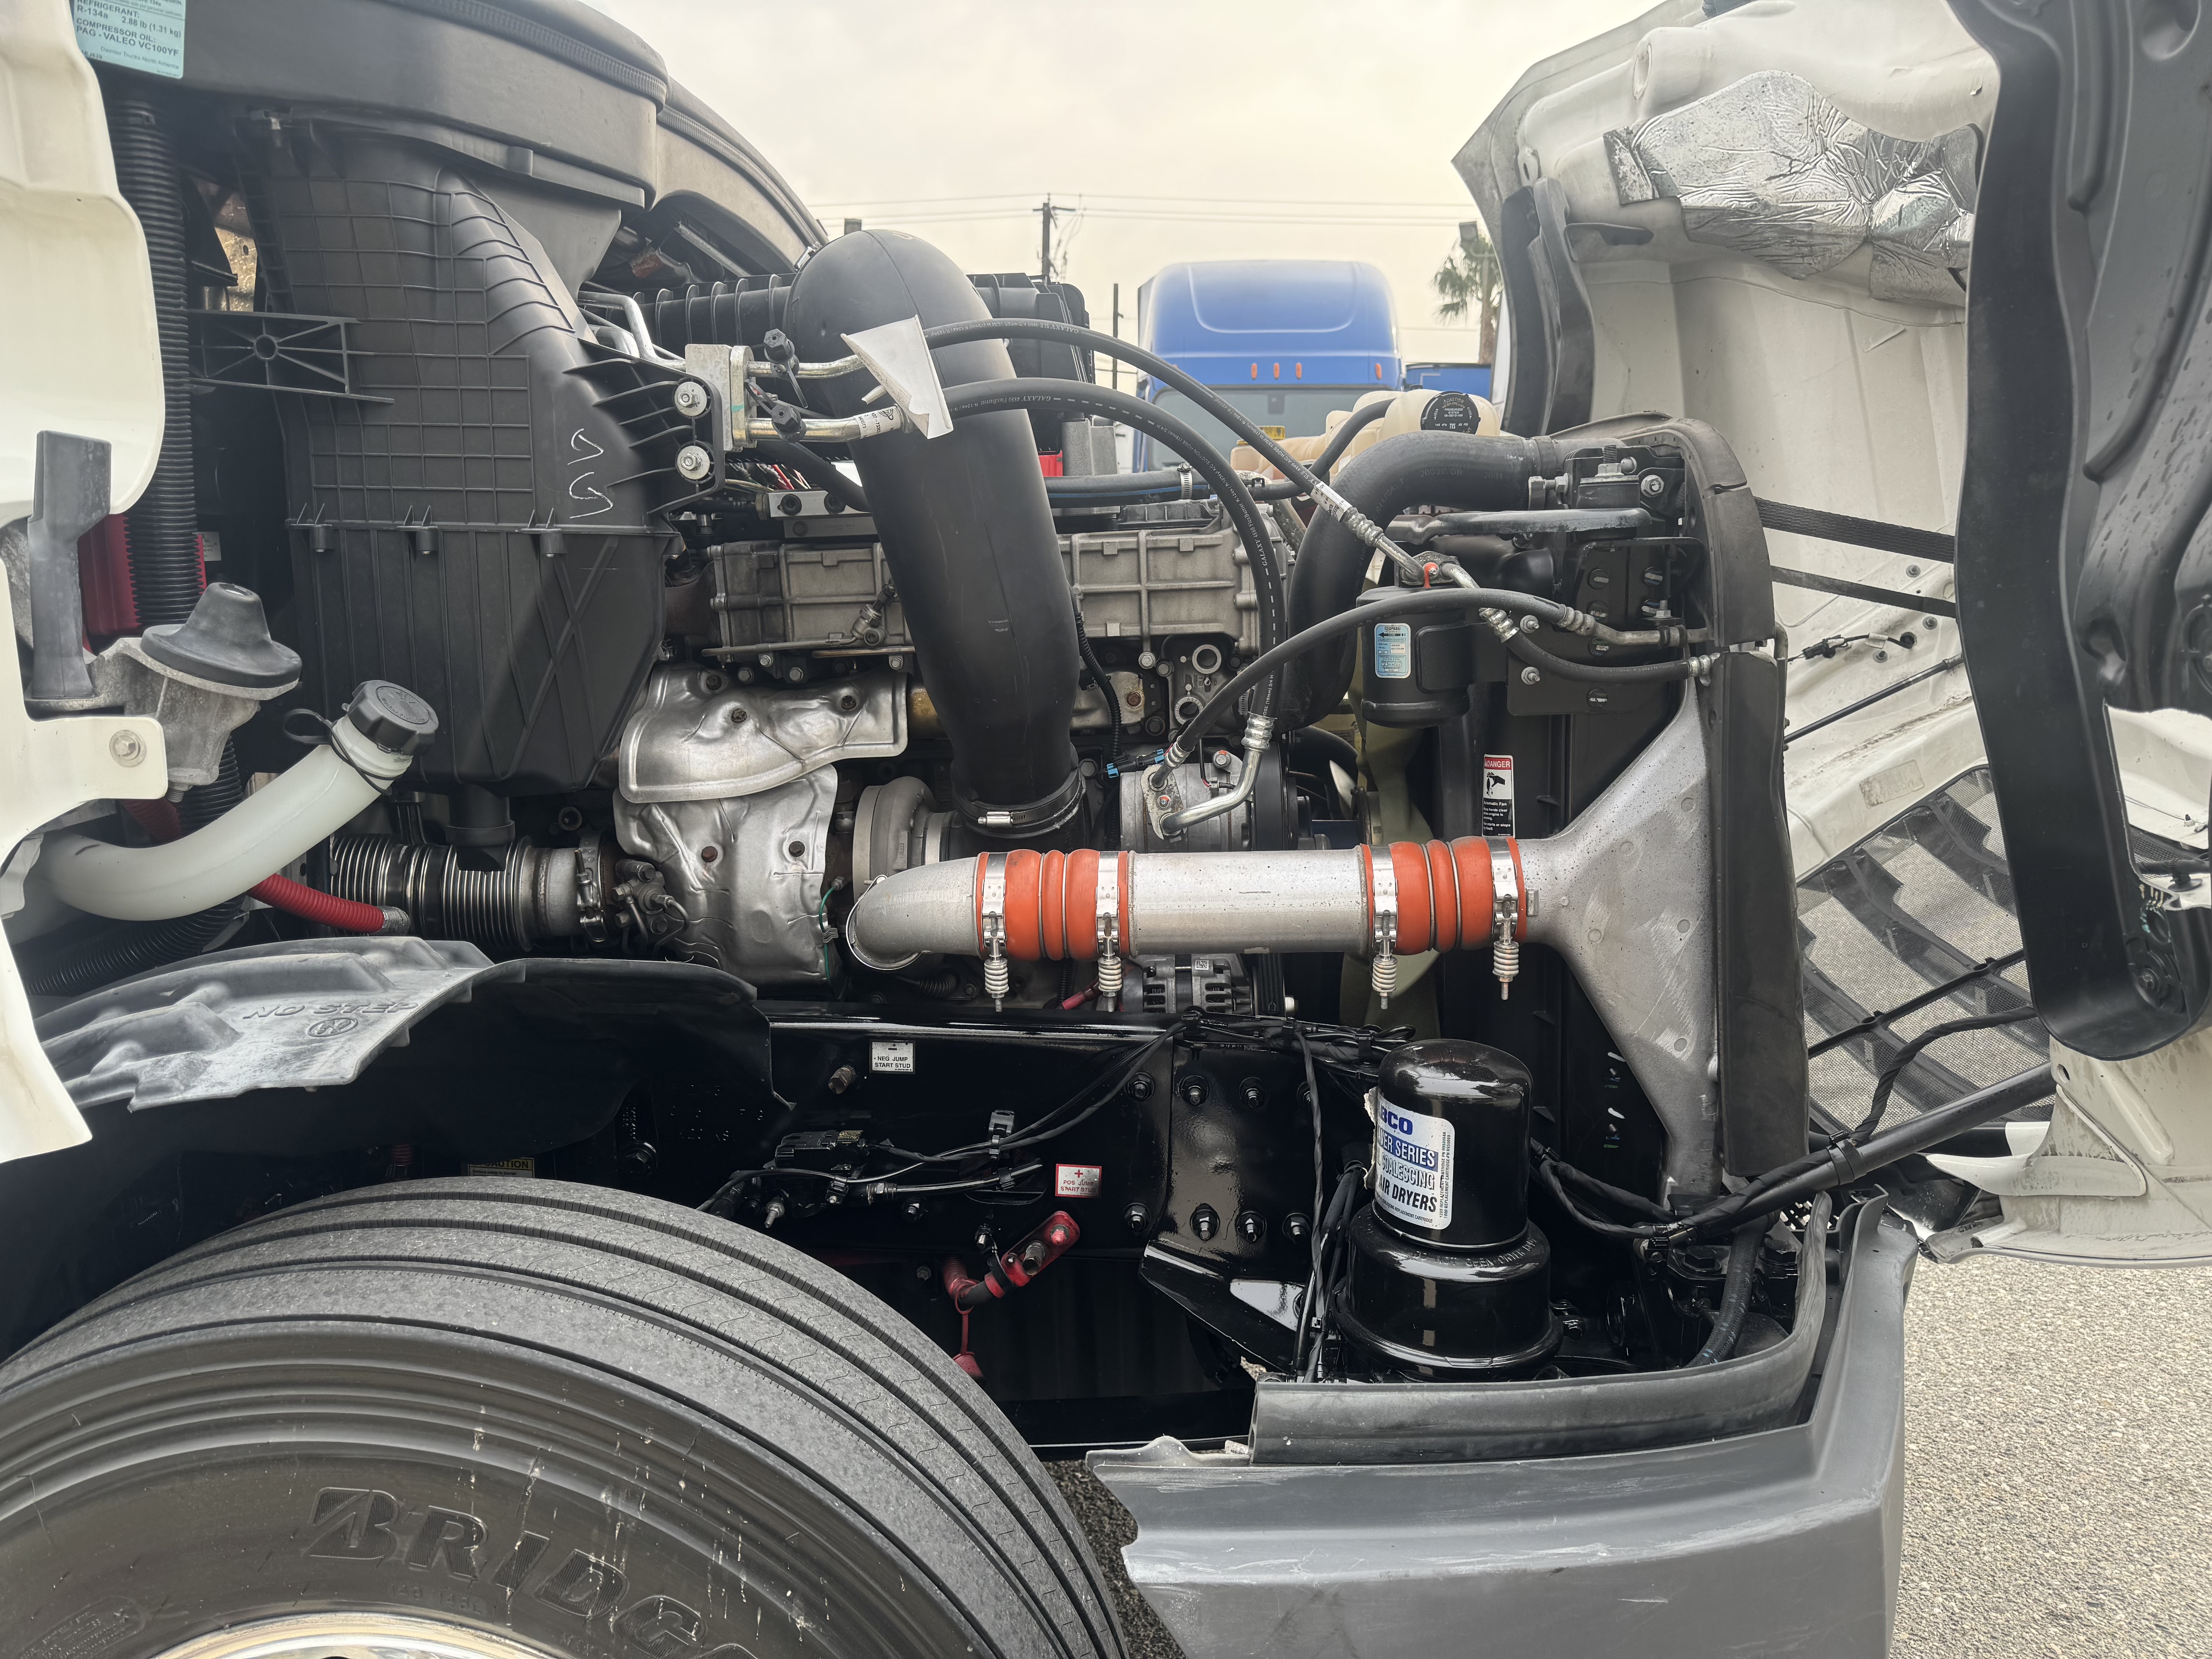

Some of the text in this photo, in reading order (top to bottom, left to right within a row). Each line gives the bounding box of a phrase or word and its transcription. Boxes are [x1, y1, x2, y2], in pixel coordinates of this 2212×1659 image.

[77, 5, 181, 38] R-134a 2.88 lb (1.31 kg)
[77, 18, 156, 43] COMPRESSOR OIL:
[77, 26, 96, 37] PAG
[103, 32, 136, 46] VALEO
[138, 41, 179, 56] VC100YF
[124, 52, 141, 60] Trucks
[158, 60, 180, 69] America
[1051, 326, 1079, 334] GALAXY
[1250, 526, 1258, 538] 4880
[1255, 539, 1268, 566] GALAXY
[243, 1001, 419, 1019] NO STEP
[1395, 1140, 1436, 1168] SERIES
[1381, 1152, 1435, 1190] COALESCING
[1379, 1174, 1437, 1213] AIR DRYERS
[1415, 1215, 1433, 1223] CARTRIDGE
[1435, 1255, 1457, 1265] NOT
[304, 1486, 759, 1659] BRIDG
